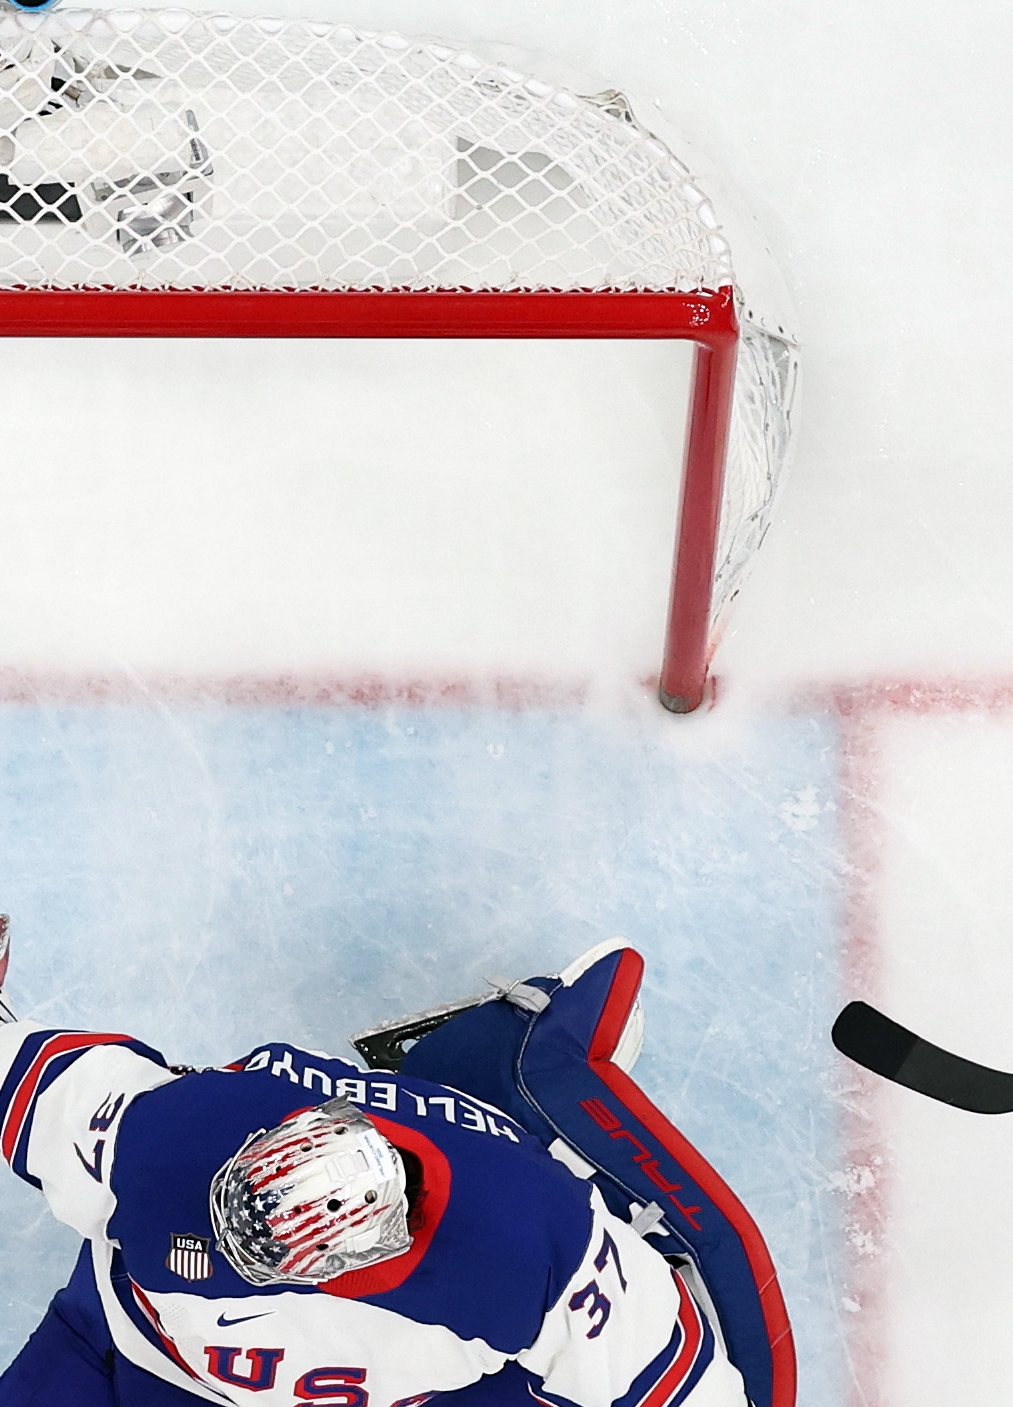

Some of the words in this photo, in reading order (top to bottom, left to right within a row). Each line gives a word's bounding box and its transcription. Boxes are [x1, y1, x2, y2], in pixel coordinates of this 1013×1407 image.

[72, 1091, 125, 1184] 37
[578, 1097, 702, 1232] TRUE
[176, 1237, 203, 1251] USA
[568, 1227, 628, 1340] 37
